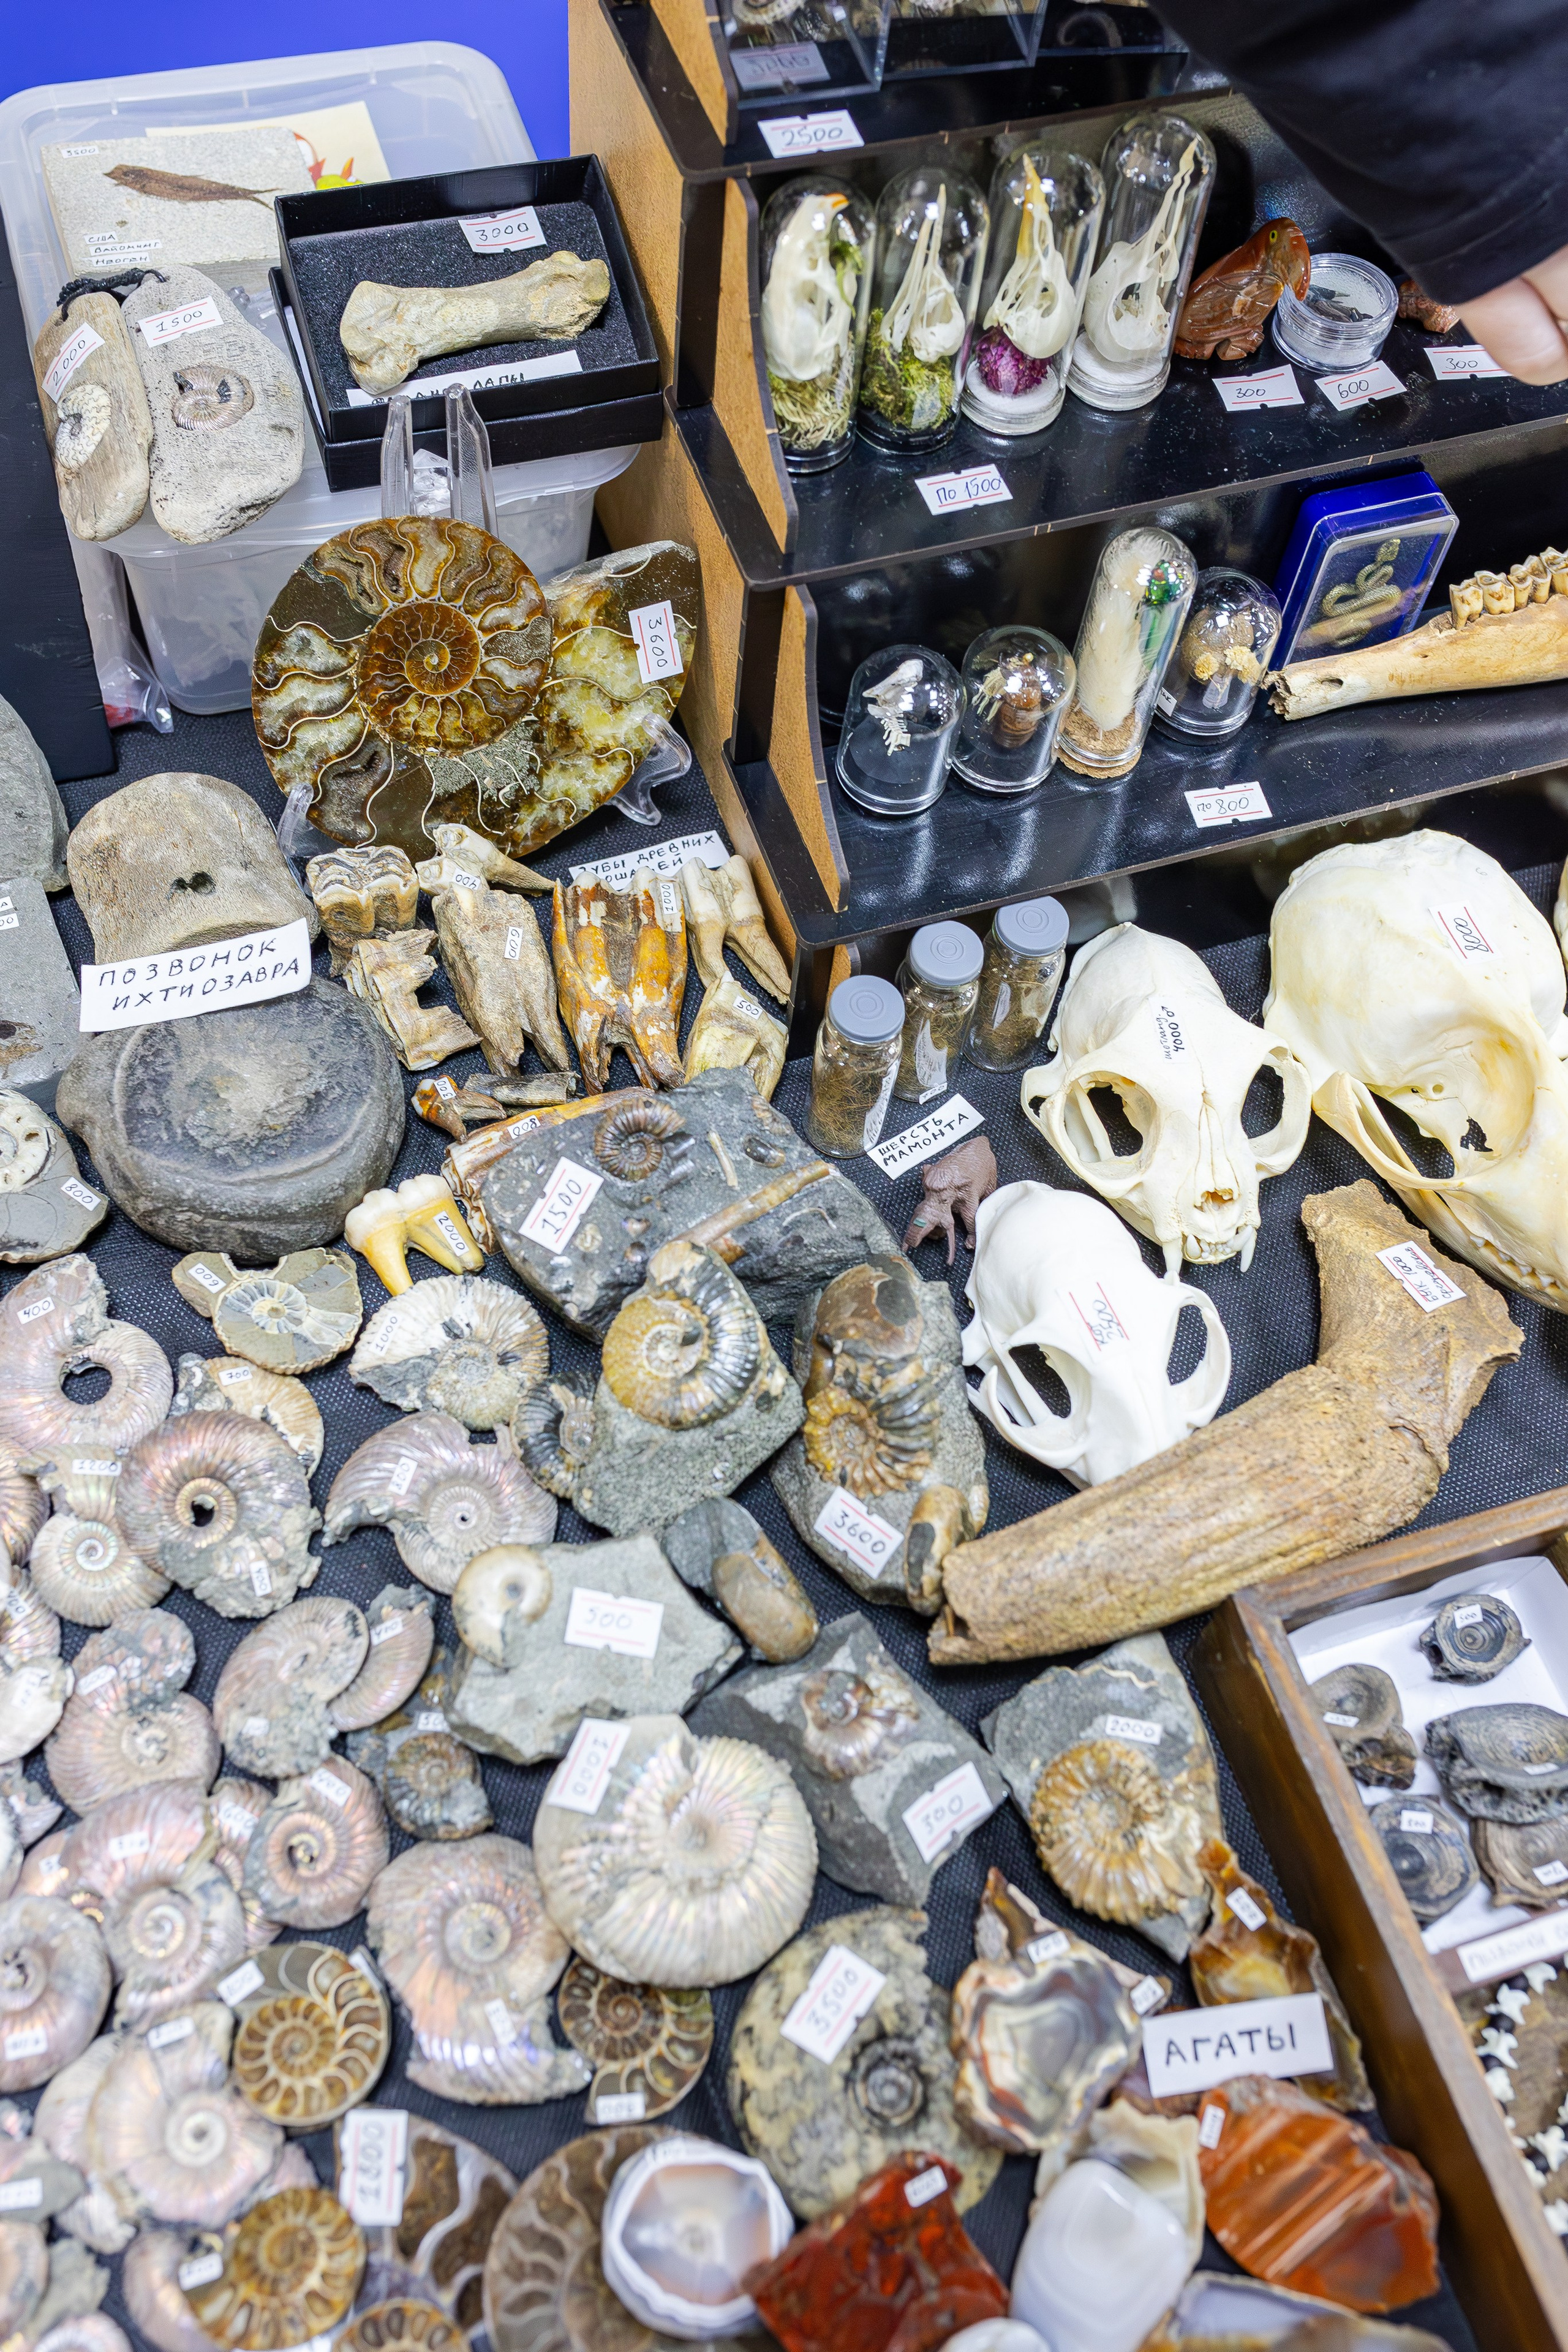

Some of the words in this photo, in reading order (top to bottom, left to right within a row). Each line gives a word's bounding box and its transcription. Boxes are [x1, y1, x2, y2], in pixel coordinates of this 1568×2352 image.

[782, 126, 843, 147] 2500
[66, 146, 96, 156] 3500
[88, 234, 116, 243] США
[475, 222, 529, 241] 3000
[94, 242, 159, 254] ВАЙОМИНГ
[156, 309, 203, 331] 1500
[53, 339, 86, 386] 2000
[1446, 357, 1478, 369] 300
[1236, 386, 1266, 398] 300
[1337, 379, 1369, 398] 600
[963, 477, 1001, 499] 1500
[649, 619, 668, 668] 3600
[1215, 796, 1249, 815] 800
[637, 835, 715, 864] ДРЕВНИХ
[605, 853, 683, 883] ОШАЕЙ
[456, 875, 477, 890] 400
[662, 884, 674, 912] 1000
[509, 929, 520, 958] 600
[1453, 917, 1488, 953] 8000
[99, 937, 276, 987] ПОЗВОНОК
[111, 957, 300, 1011] ИХТИОЗАВРА
[737, 1000, 759, 1015] 500
[1168, 1022, 1185, 1052] 4000
[437, 1080, 453, 1098] 300
[513, 1118, 537, 1136] 800
[878, 1118, 943, 1156] ШЕРСТЬ
[883, 1113, 969, 1167] МАМОНТА
[65, 1184, 93, 1204] 800
[542, 1180, 581, 1235] 1500
[439, 1216, 464, 1250] 2000
[195, 1268, 219, 1286] 600
[1392, 1256, 1414, 1276] 1000
[24, 1300, 50, 1317] 400
[1092, 1299, 1124, 1340] 2500
[375, 1316, 398, 1352] 1000
[227, 1369, 249, 1379] 700
[78, 1461, 118, 1472] 1200
[834, 1510, 885, 1555] 3600
[1112, 1719, 1155, 1738] 2000
[573, 1738, 608, 1796] 1000
[807, 1969, 858, 2036] 3500
[1165, 2022, 1297, 2067] АГАТЫ
